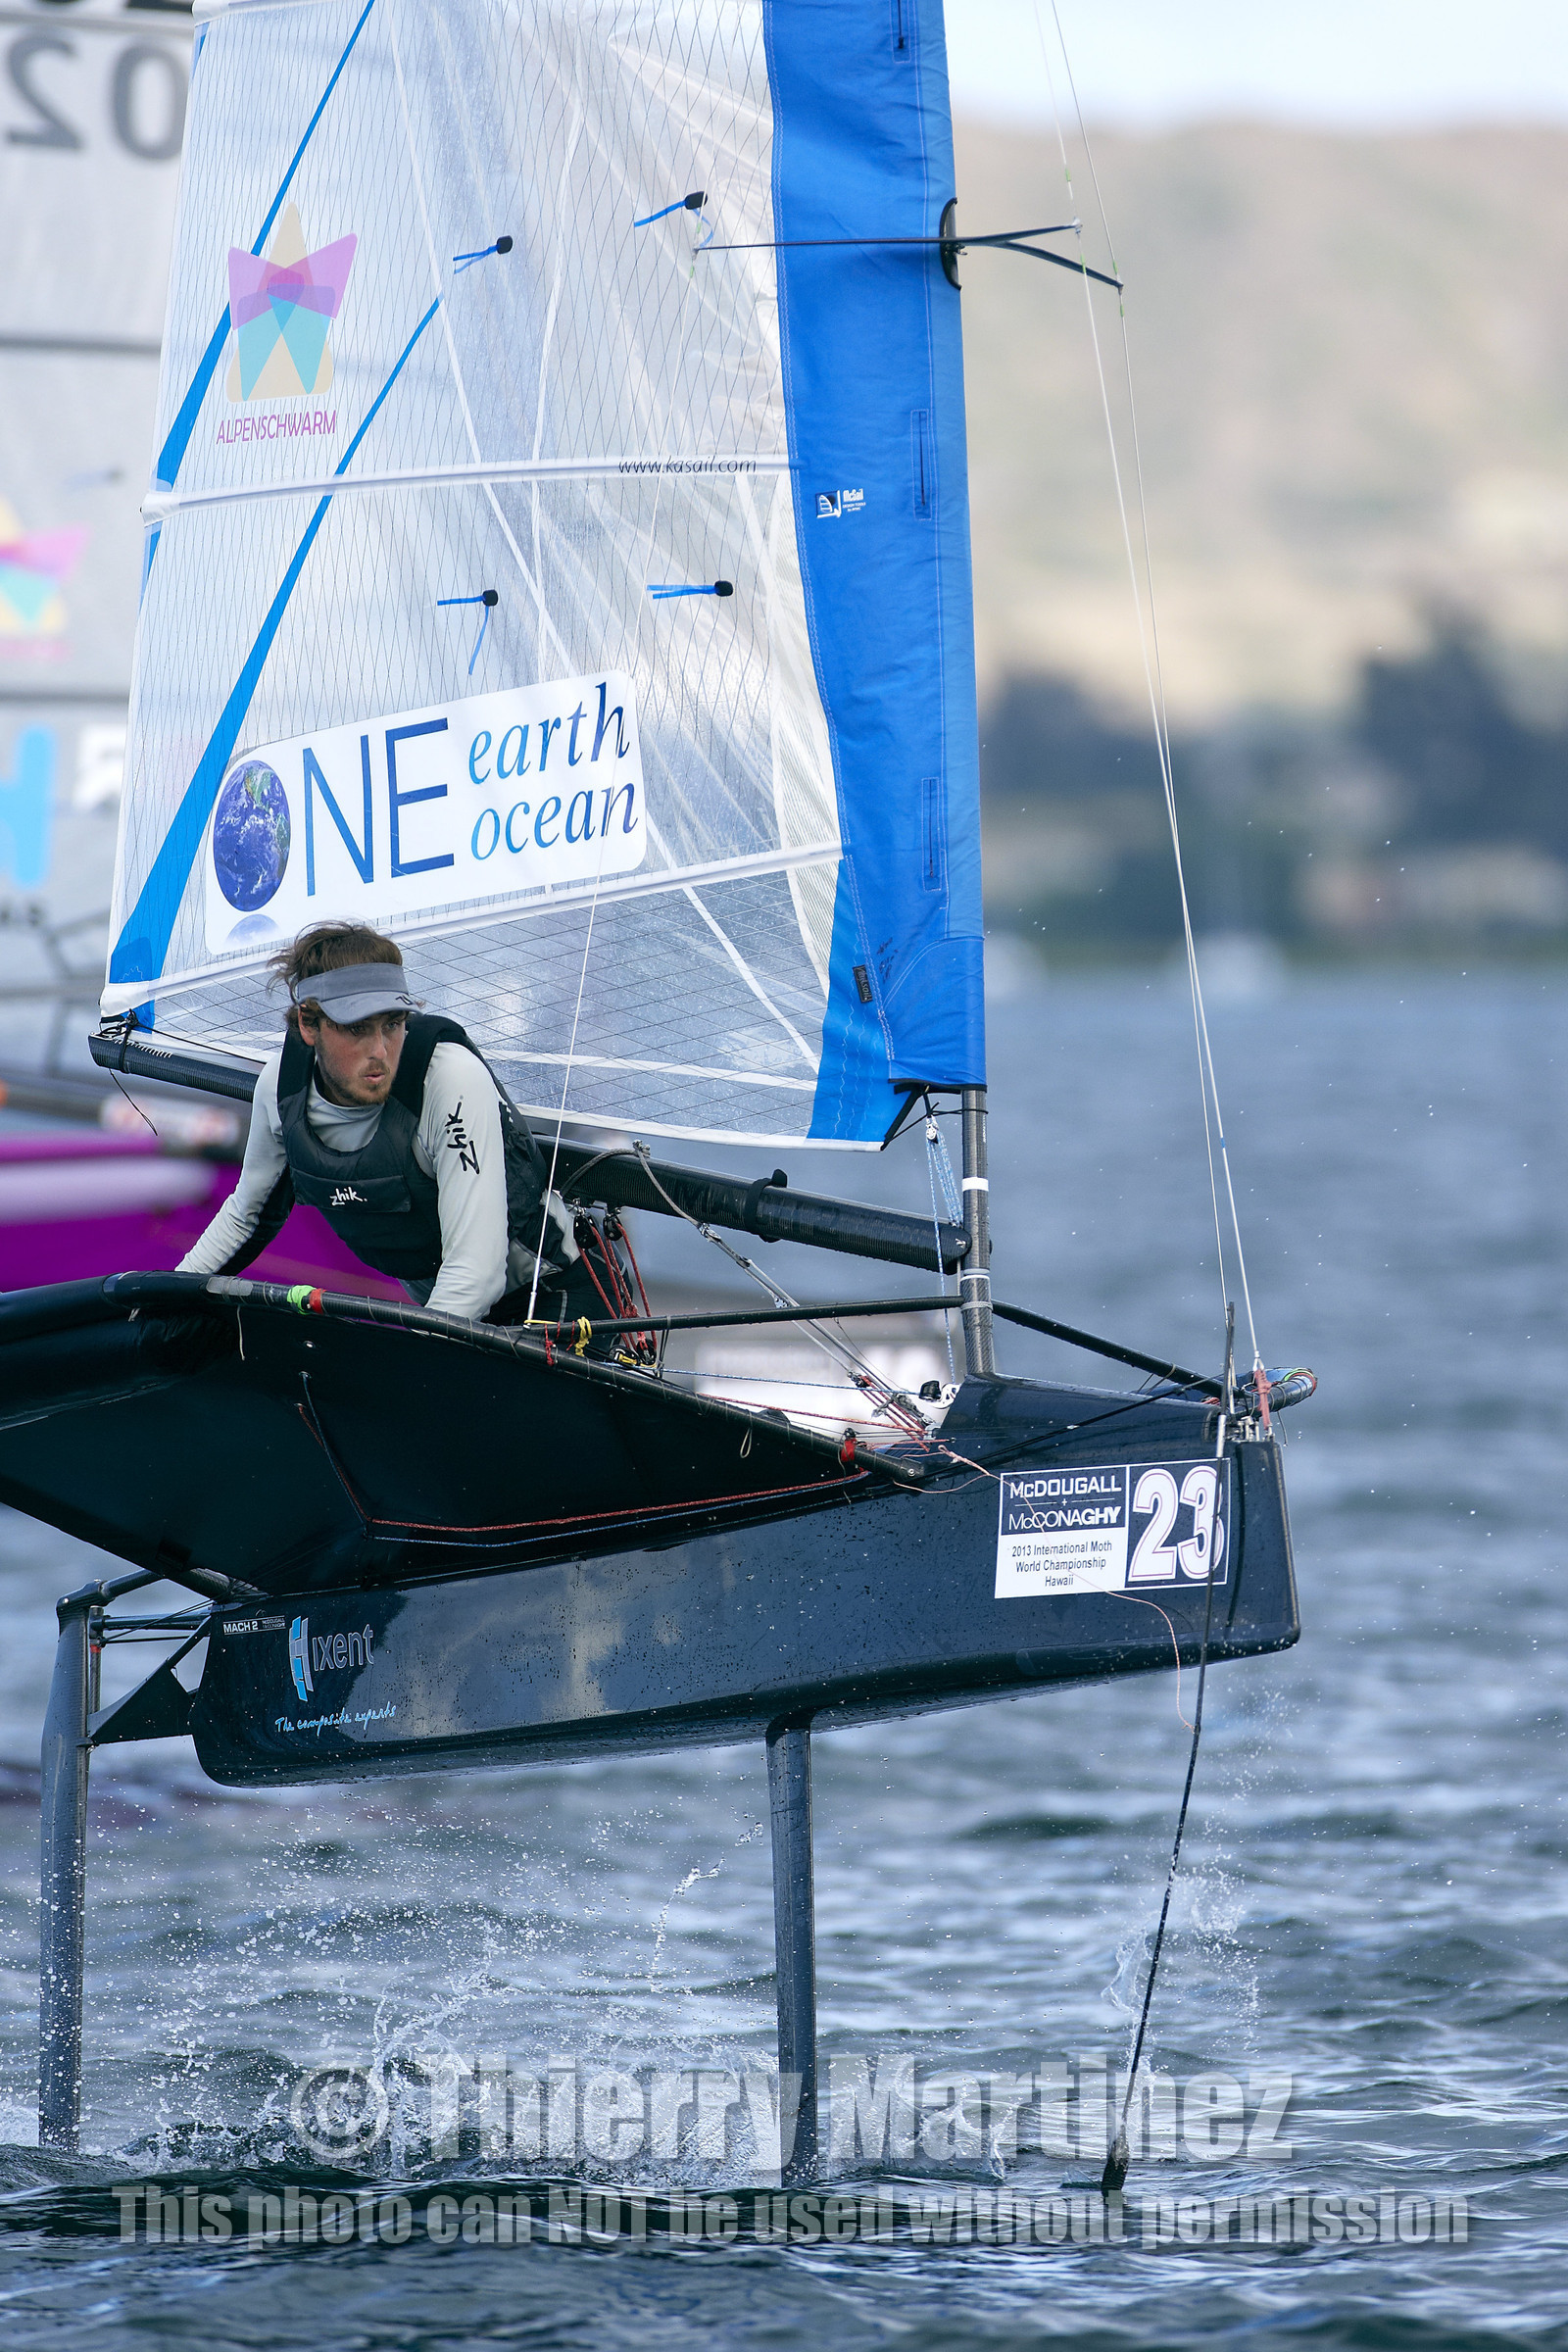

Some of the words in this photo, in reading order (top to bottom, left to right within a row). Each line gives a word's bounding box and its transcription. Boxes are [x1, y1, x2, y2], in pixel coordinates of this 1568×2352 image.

[216, 410, 337, 445] ALPENSCHWARM
[618, 455, 758, 473] www.kasail.com
[468, 681, 630, 785] earth
[470, 782, 639, 860] ocean
[1008, 1506, 1122, 1531] McCONAGHY
[1128, 1465, 1225, 1582] 23
[1011, 1544, 1032, 1558] 2013
[1033, 1542, 1088, 1556] International
[1090, 1541, 1113, 1552] Moth
[1015, 1560, 1042, 1573] World
[1043, 1558, 1106, 1572] Championship
[1045, 1574, 1074, 1588] Hawaii
[223, 1622, 250, 1634] MACH
[251, 1620, 259, 1631] 2
[275, 1716, 294, 1733] The
[296, 1707, 352, 1737] composite
[355, 1701, 397, 1731] experts
